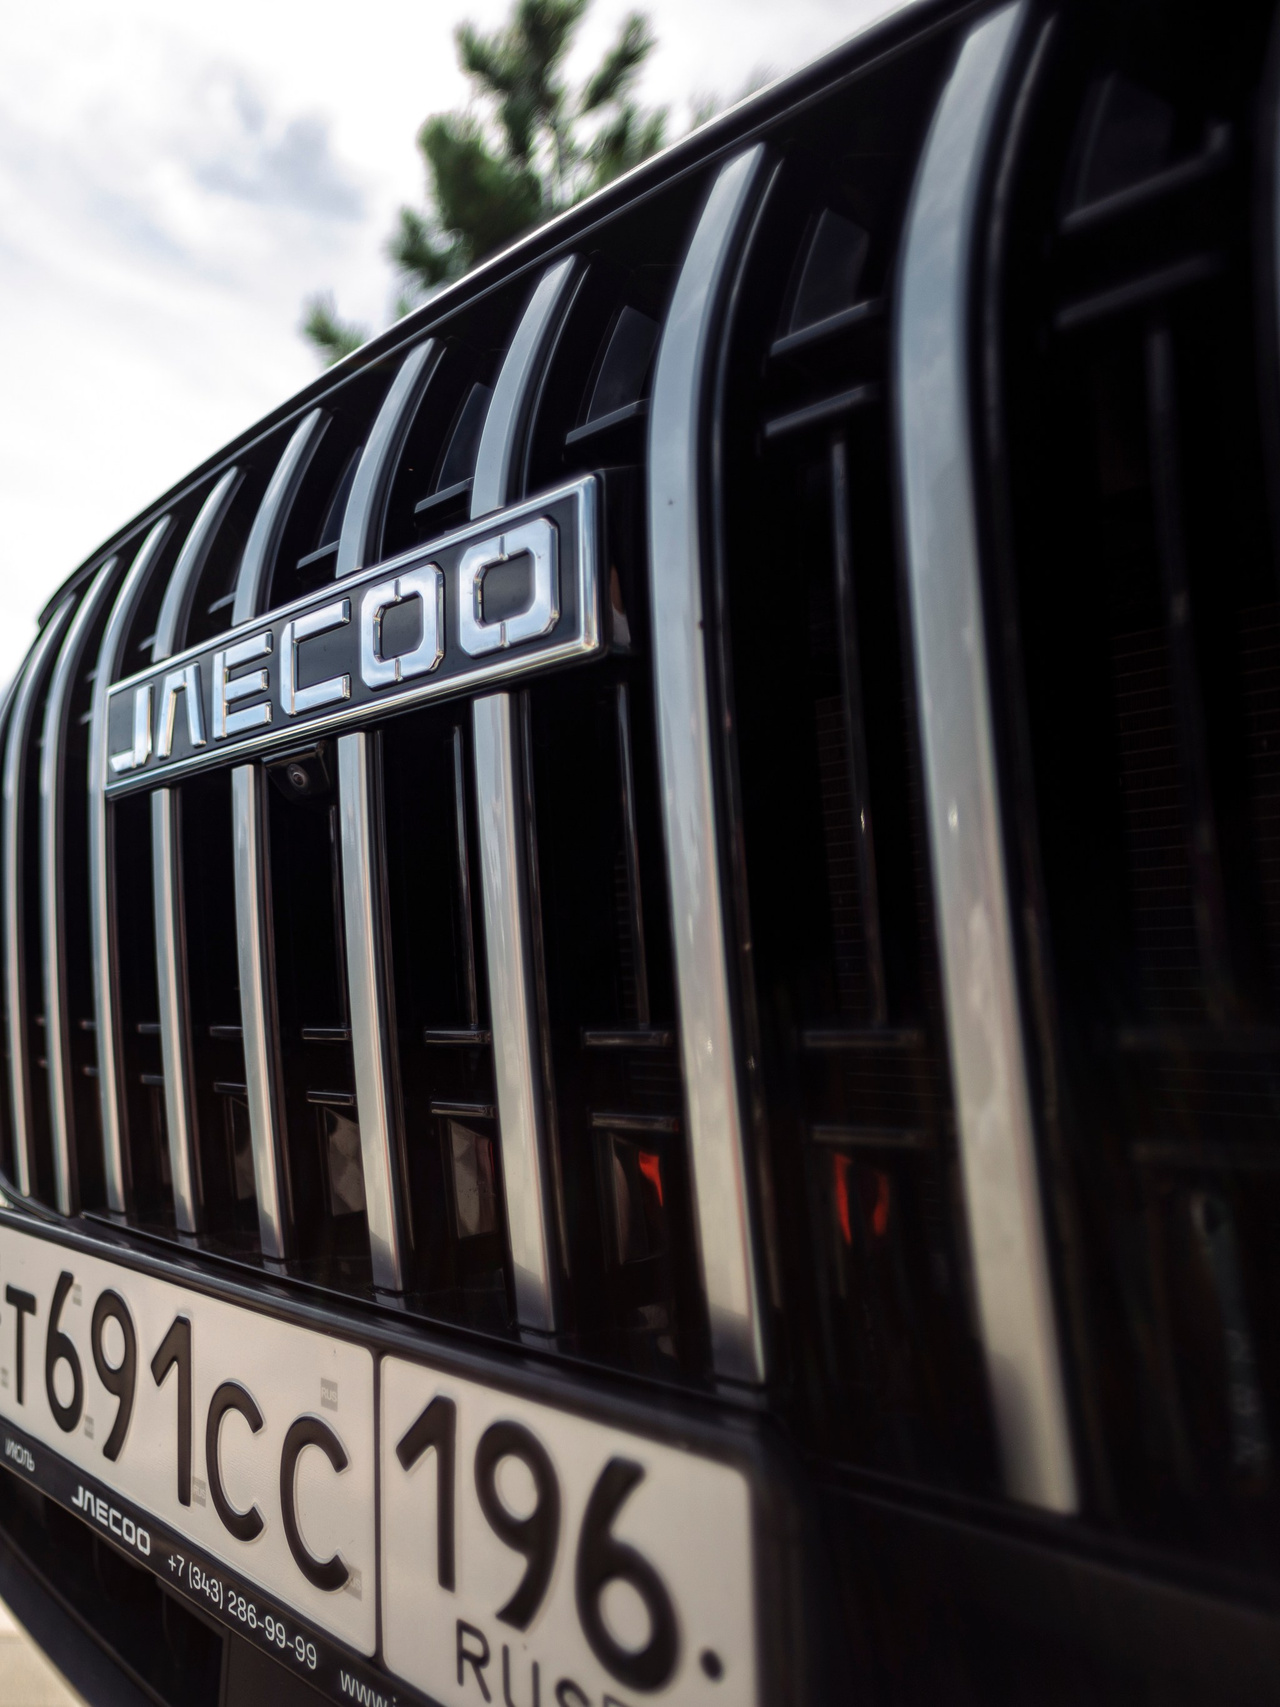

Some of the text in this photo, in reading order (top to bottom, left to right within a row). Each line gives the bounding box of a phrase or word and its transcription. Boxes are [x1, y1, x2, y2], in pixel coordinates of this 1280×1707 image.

[109, 516, 559, 774] JAECOO
[71, 1485, 151, 1556] JAECOO
[168, 1554, 317, 1670] +7 (343) 286-99-99
[395, 1394, 682, 1695] 196
